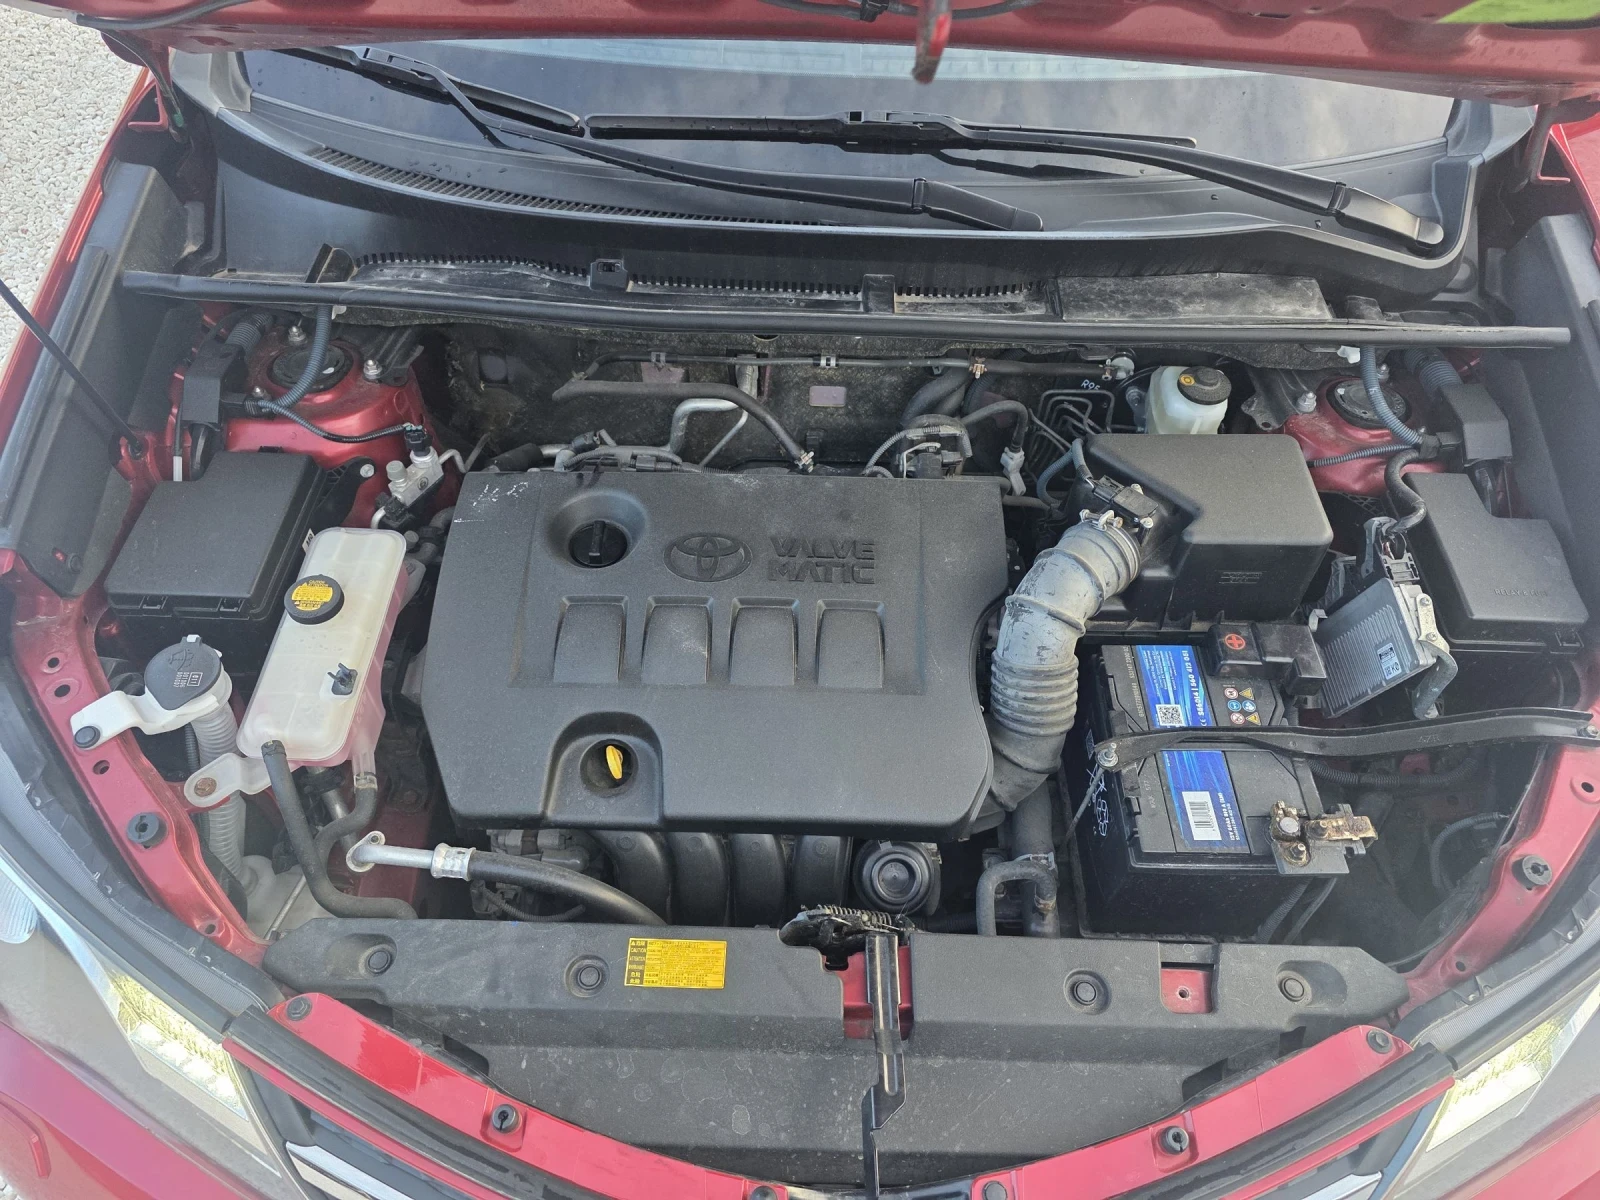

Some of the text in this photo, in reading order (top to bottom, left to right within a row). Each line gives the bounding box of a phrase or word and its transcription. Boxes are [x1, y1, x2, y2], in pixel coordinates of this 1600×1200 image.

[770, 537, 875, 560] VALVE
[768, 561, 875, 584] MATIC
[1182, 650, 1190, 661] 051
[1185, 663, 1193, 673] 412
[1188, 674, 1196, 687] 560
